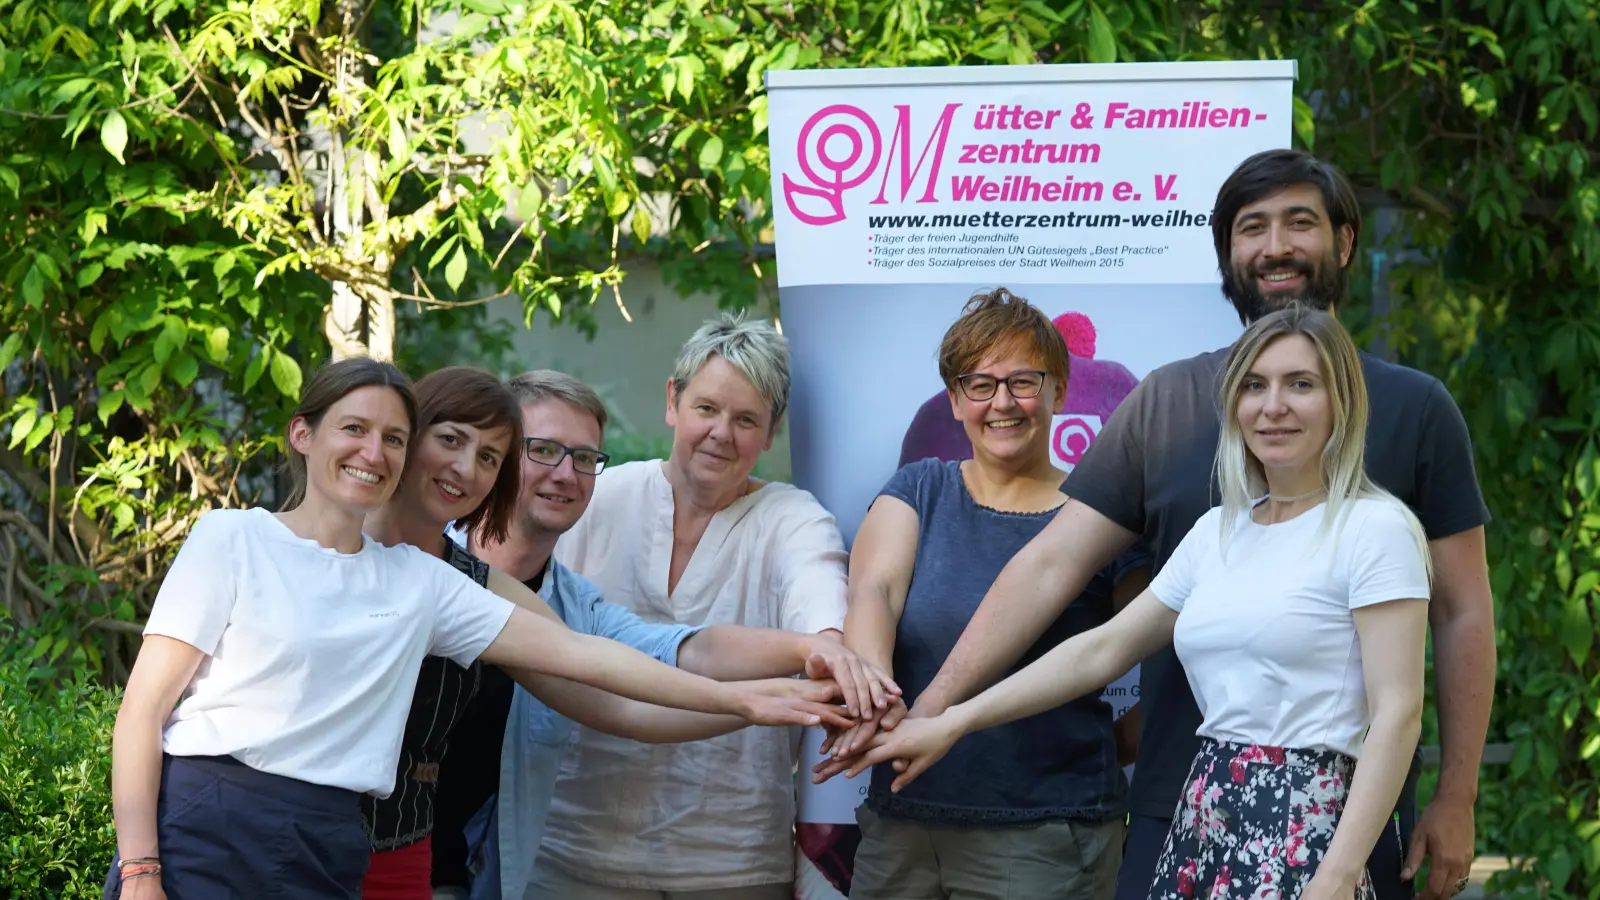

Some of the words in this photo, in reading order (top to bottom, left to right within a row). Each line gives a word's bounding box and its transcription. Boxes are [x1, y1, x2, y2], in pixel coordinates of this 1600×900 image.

[1070, 102, 1094, 129] &
[1104, 101, 1267, 129] Familien-
[958, 139, 1101, 163] zentrum
[951, 175, 1104, 202] Weilheim
[1112, 181, 1141, 202] e.
[1154, 174, 1178, 201] V.
[869, 210, 1213, 228] www.muetterzentrum-weilhei
[873, 233, 904, 245] Träger
[907, 233, 924, 243] der
[927, 233, 956, 242] freien
[959, 233, 1019, 244] Jugendhilfe
[873, 246, 904, 257] Träger
[907, 246, 925, 255] des
[928, 245, 1005, 255] internationalen
[1008, 246, 1025, 254] UN
[1027, 245, 1087, 256] Gütesiegels
[873, 258, 904, 269] Träger
[907, 258, 925, 267] des
[928, 257, 996, 268] Sozialpreises
[999, 258, 1016, 267] der
[1019, 258, 1047, 267] Stadt
[1050, 258, 1096, 267] Weilheim
[1099, 258, 1124, 267] 2015
